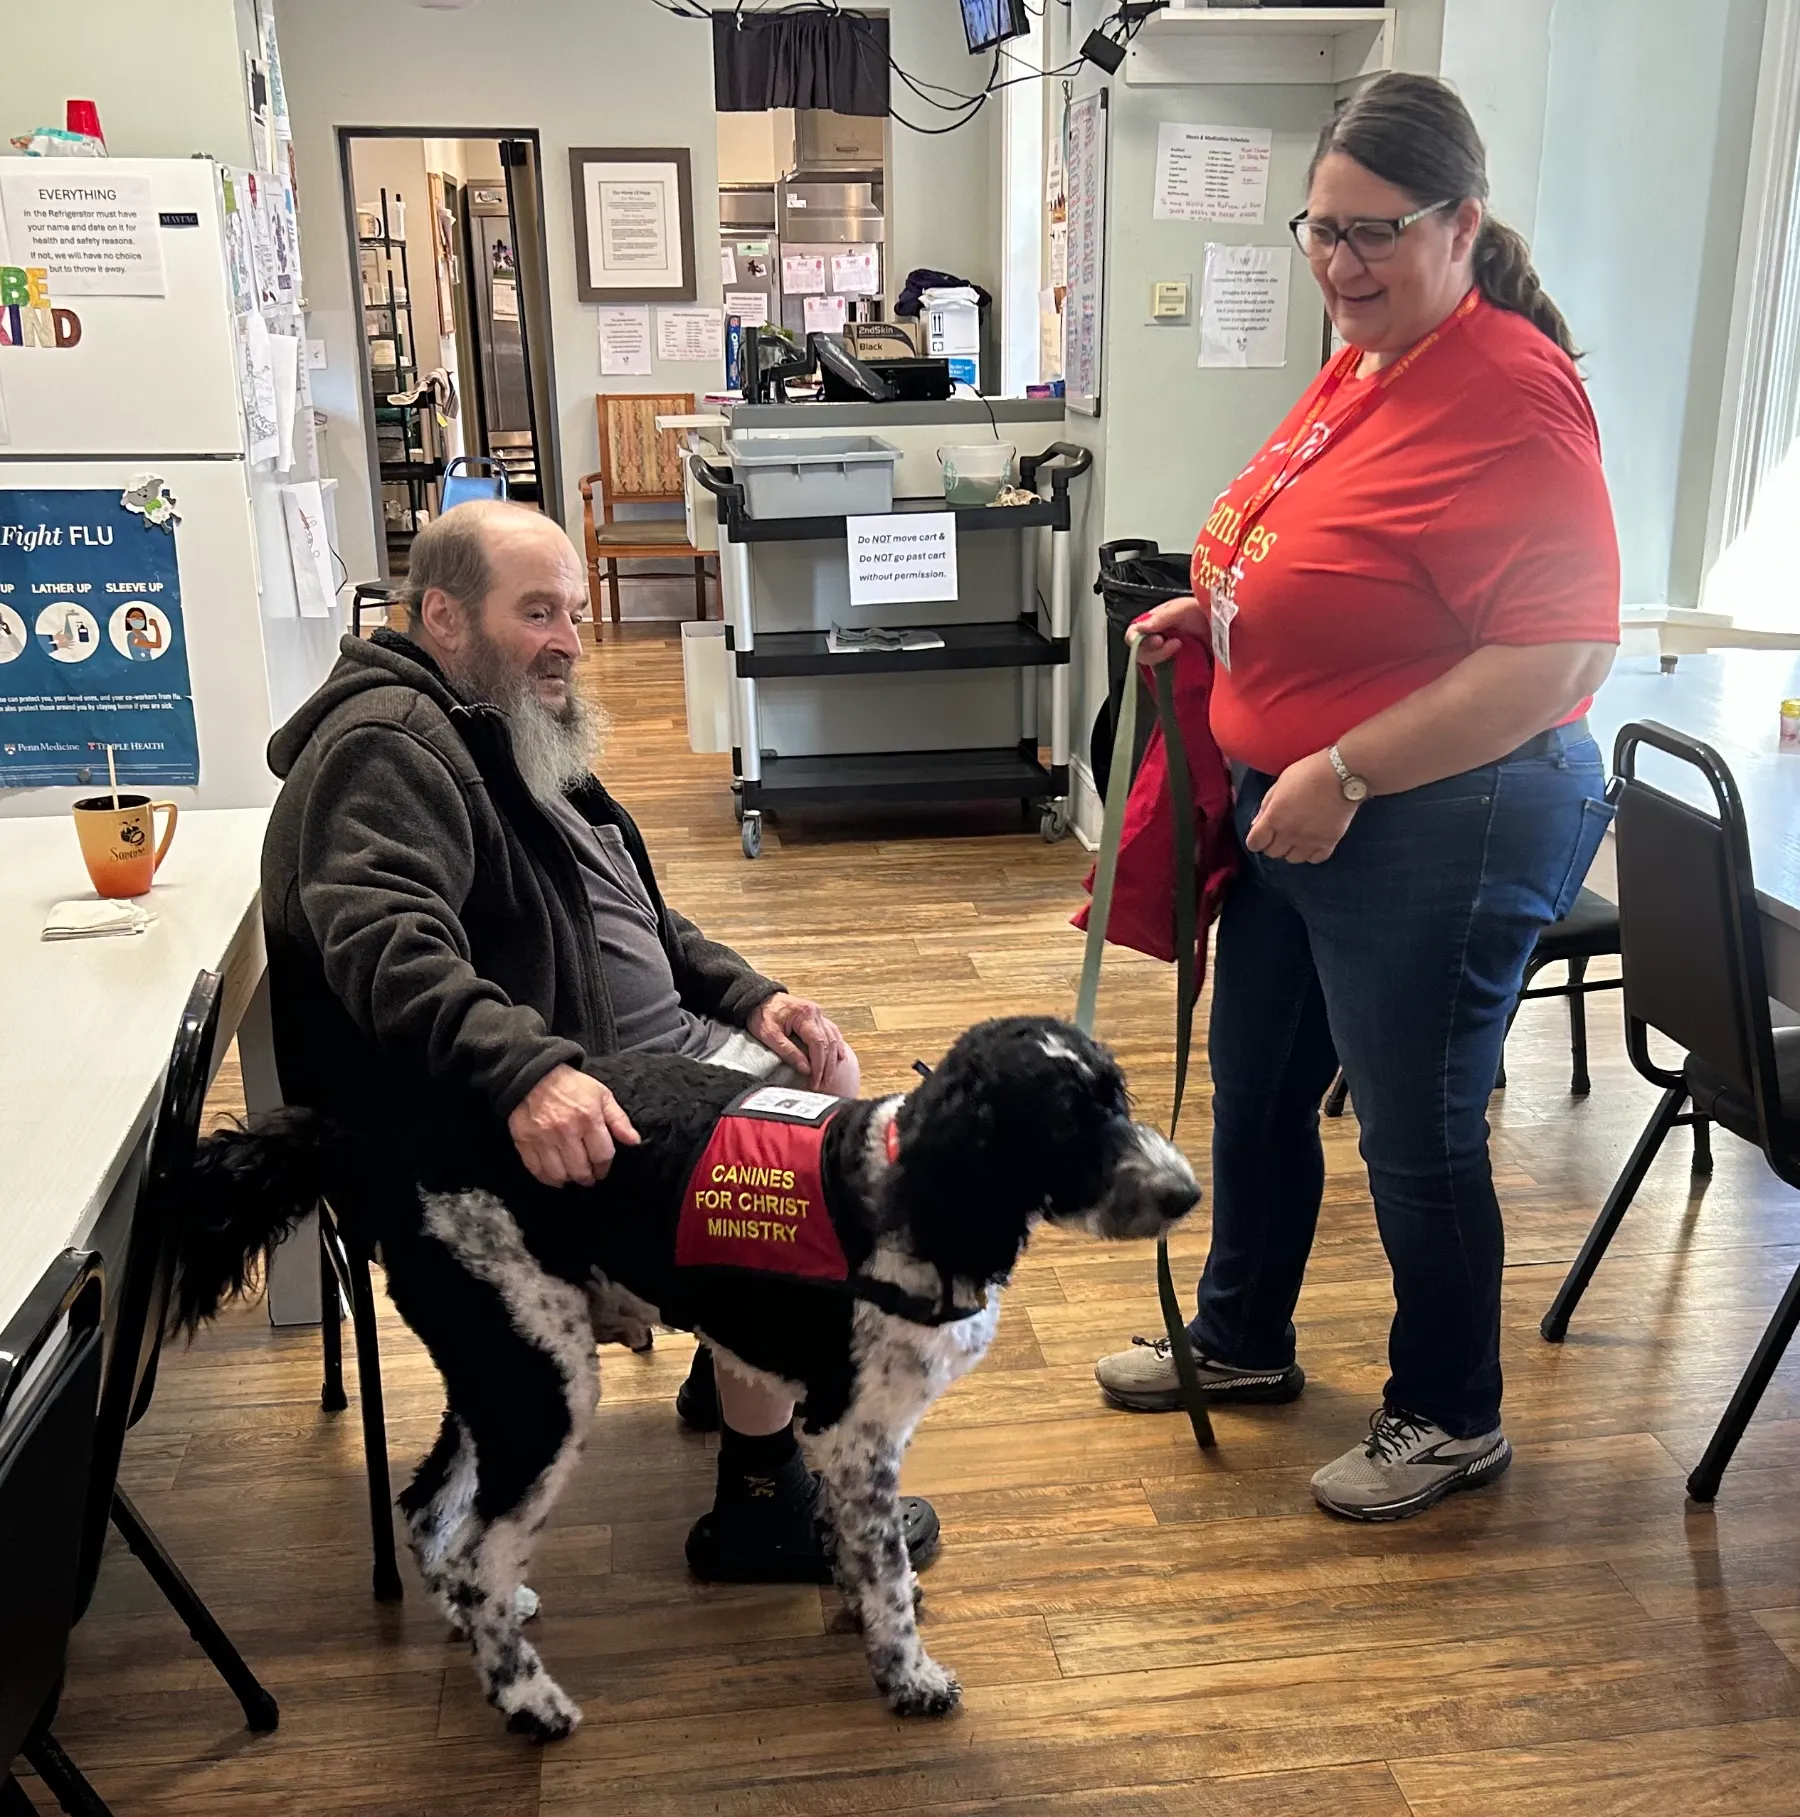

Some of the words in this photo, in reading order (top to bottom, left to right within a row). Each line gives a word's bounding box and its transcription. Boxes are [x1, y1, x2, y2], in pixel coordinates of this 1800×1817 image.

[39, 189, 116, 200] EVERYTHING
[34, 210, 46, 218] the
[48, 210, 94, 219] Refrigerator
[118, 210, 137, 218] have
[162, 215, 197, 223] MAYTAG
[27, 224, 44, 232] your
[126, 224, 136, 232] for
[33, 236, 58, 244] health
[60, 236, 74, 244] and
[76, 236, 100, 246] safety
[38, 252, 53, 260] not,
[68, 252, 81, 260] will
[83, 252, 102, 260] have
[115, 252, 142, 260] choice
[49, 264, 62, 272] but
[105, 266, 126, 274] away.
[1, 266, 51, 309] BE
[859, 325, 894, 335] 2ndSkin
[860, 342, 883, 351] Black
[1, 524, 64, 552] Fight
[69, 525, 114, 546] FLU
[858, 536, 870, 544] Do
[872, 534, 892, 544] NOT
[919, 534, 937, 542] cart
[938, 532, 946, 540] &
[860, 554, 872, 562] Do
[874, 553, 893, 562] NOT
[894, 555, 904, 563] go
[906, 552, 926, 562] past
[928, 552, 946, 560] cart
[860, 573, 892, 582] without
[894, 570, 946, 582] permission.
[32, 584, 74, 594] LATHER
[76, 584, 92, 594] UP
[106, 582, 146, 593] SLEEVE
[148, 582, 164, 592] UP
[18, 704, 38, 712] protect
[162, 702, 174, 710] sick.
[18, 743, 40, 752] Penn
[40, 742, 80, 750] Medicine
[131, 742, 164, 750] HEALTH
[711, 1164, 795, 1190] CANINES
[695, 1190, 732, 1210] FOR
[738, 1192, 810, 1219] CHRIST
[707, 1217, 799, 1243] MINISTRY
